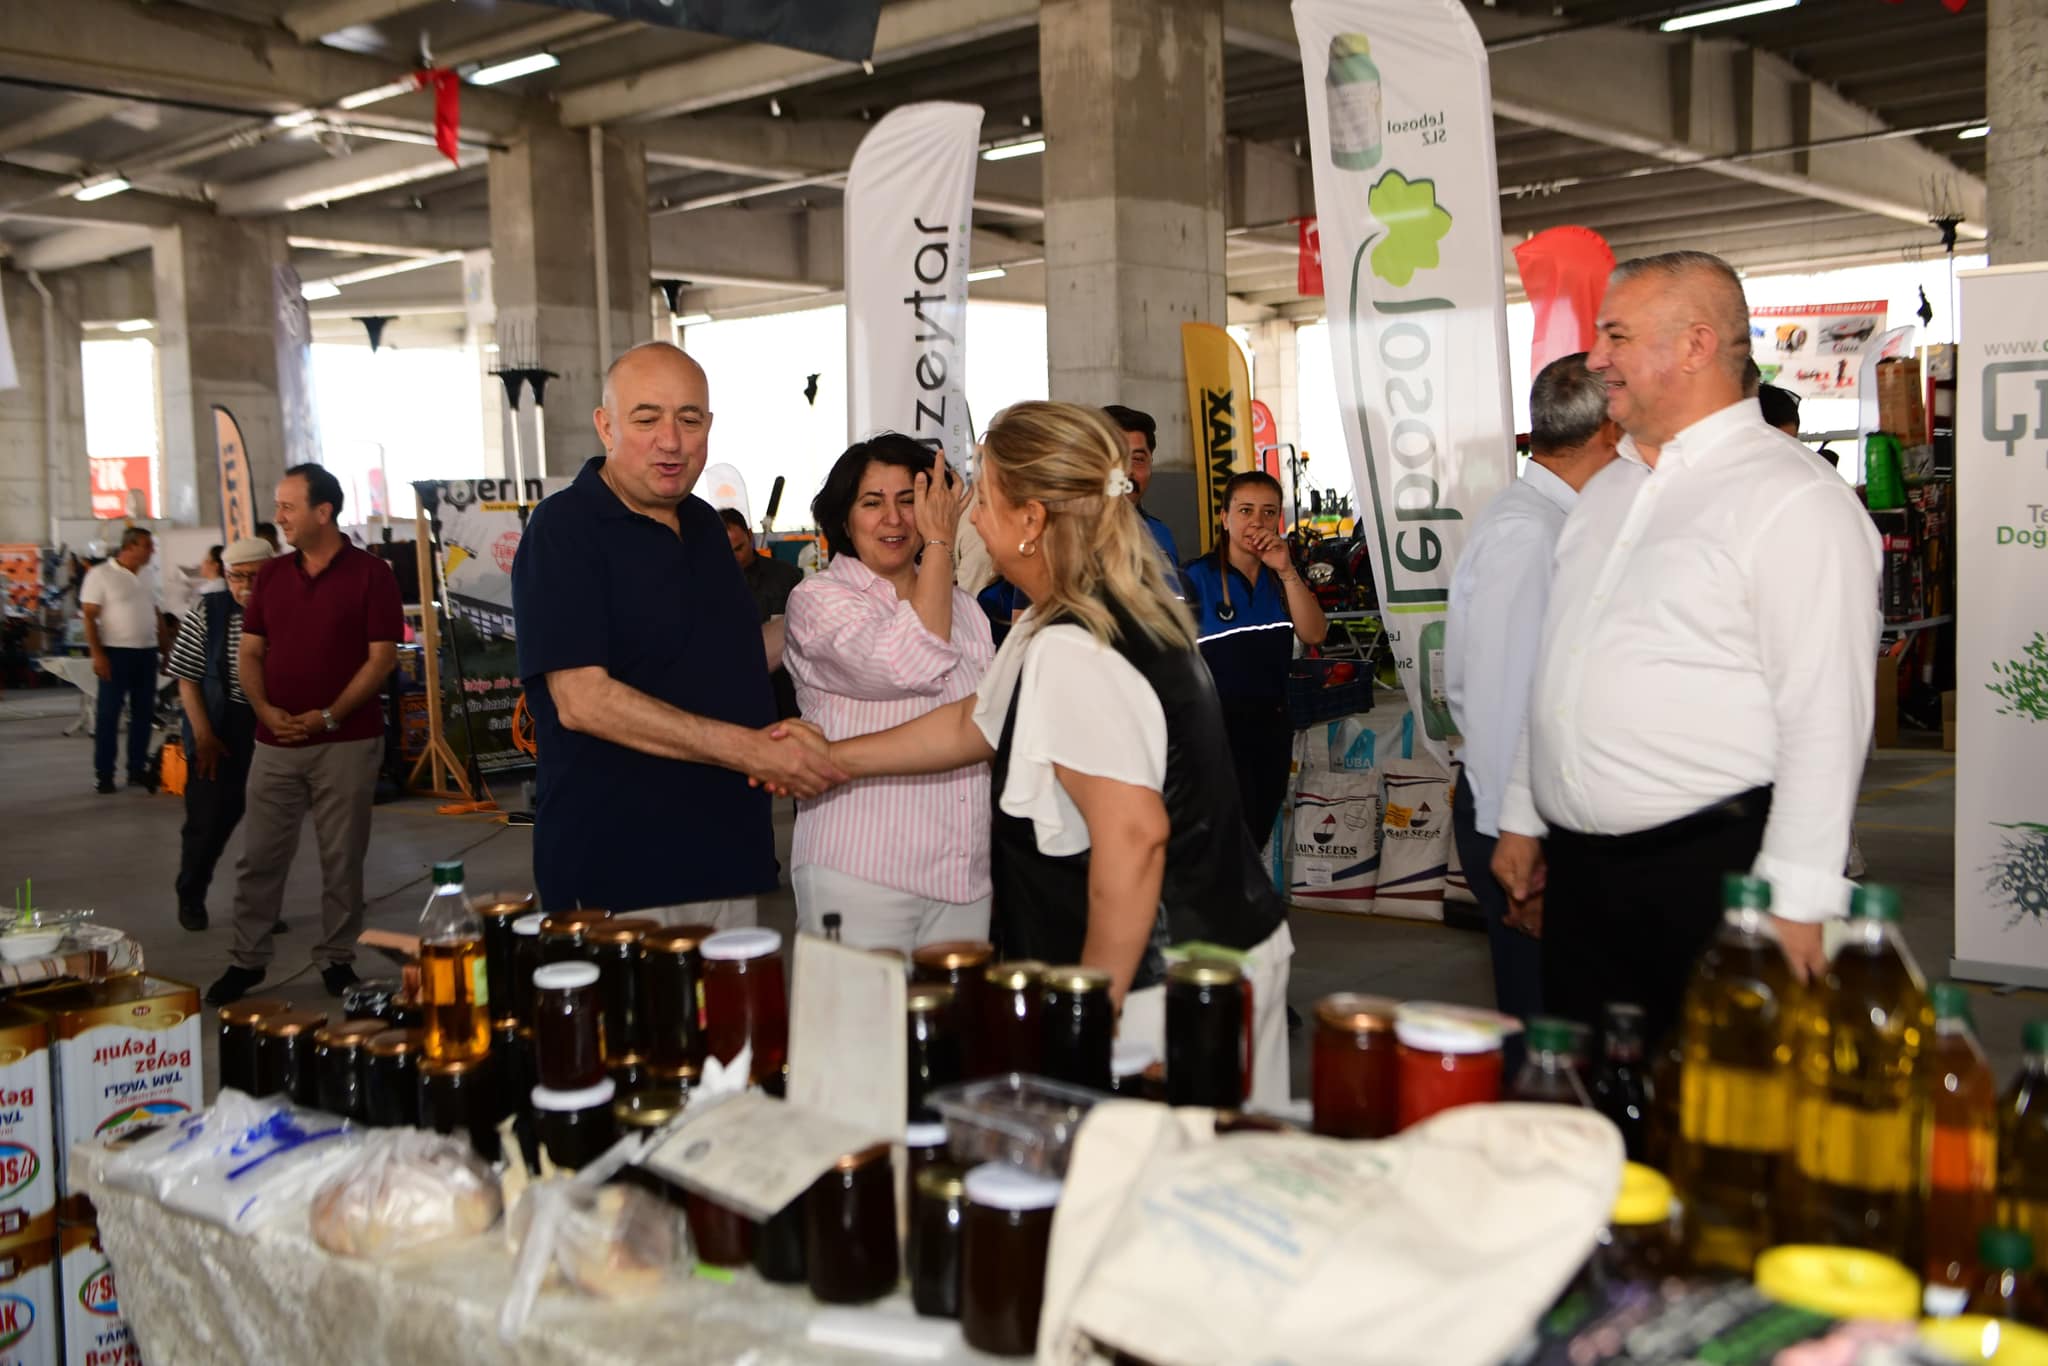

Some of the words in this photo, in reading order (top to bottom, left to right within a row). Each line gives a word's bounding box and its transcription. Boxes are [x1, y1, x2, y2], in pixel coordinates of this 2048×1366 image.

[1984, 341, 2048, 357] www.
[1296, 843, 1315, 854] AIN
[1317, 845, 1358, 856] SEEDS
[93, 1038, 157, 1066] Peynir
[135, 1049, 191, 1074] Beyaz
[152, 1071, 183, 1086] TAM
[96, 1327, 128, 1346] TAM
